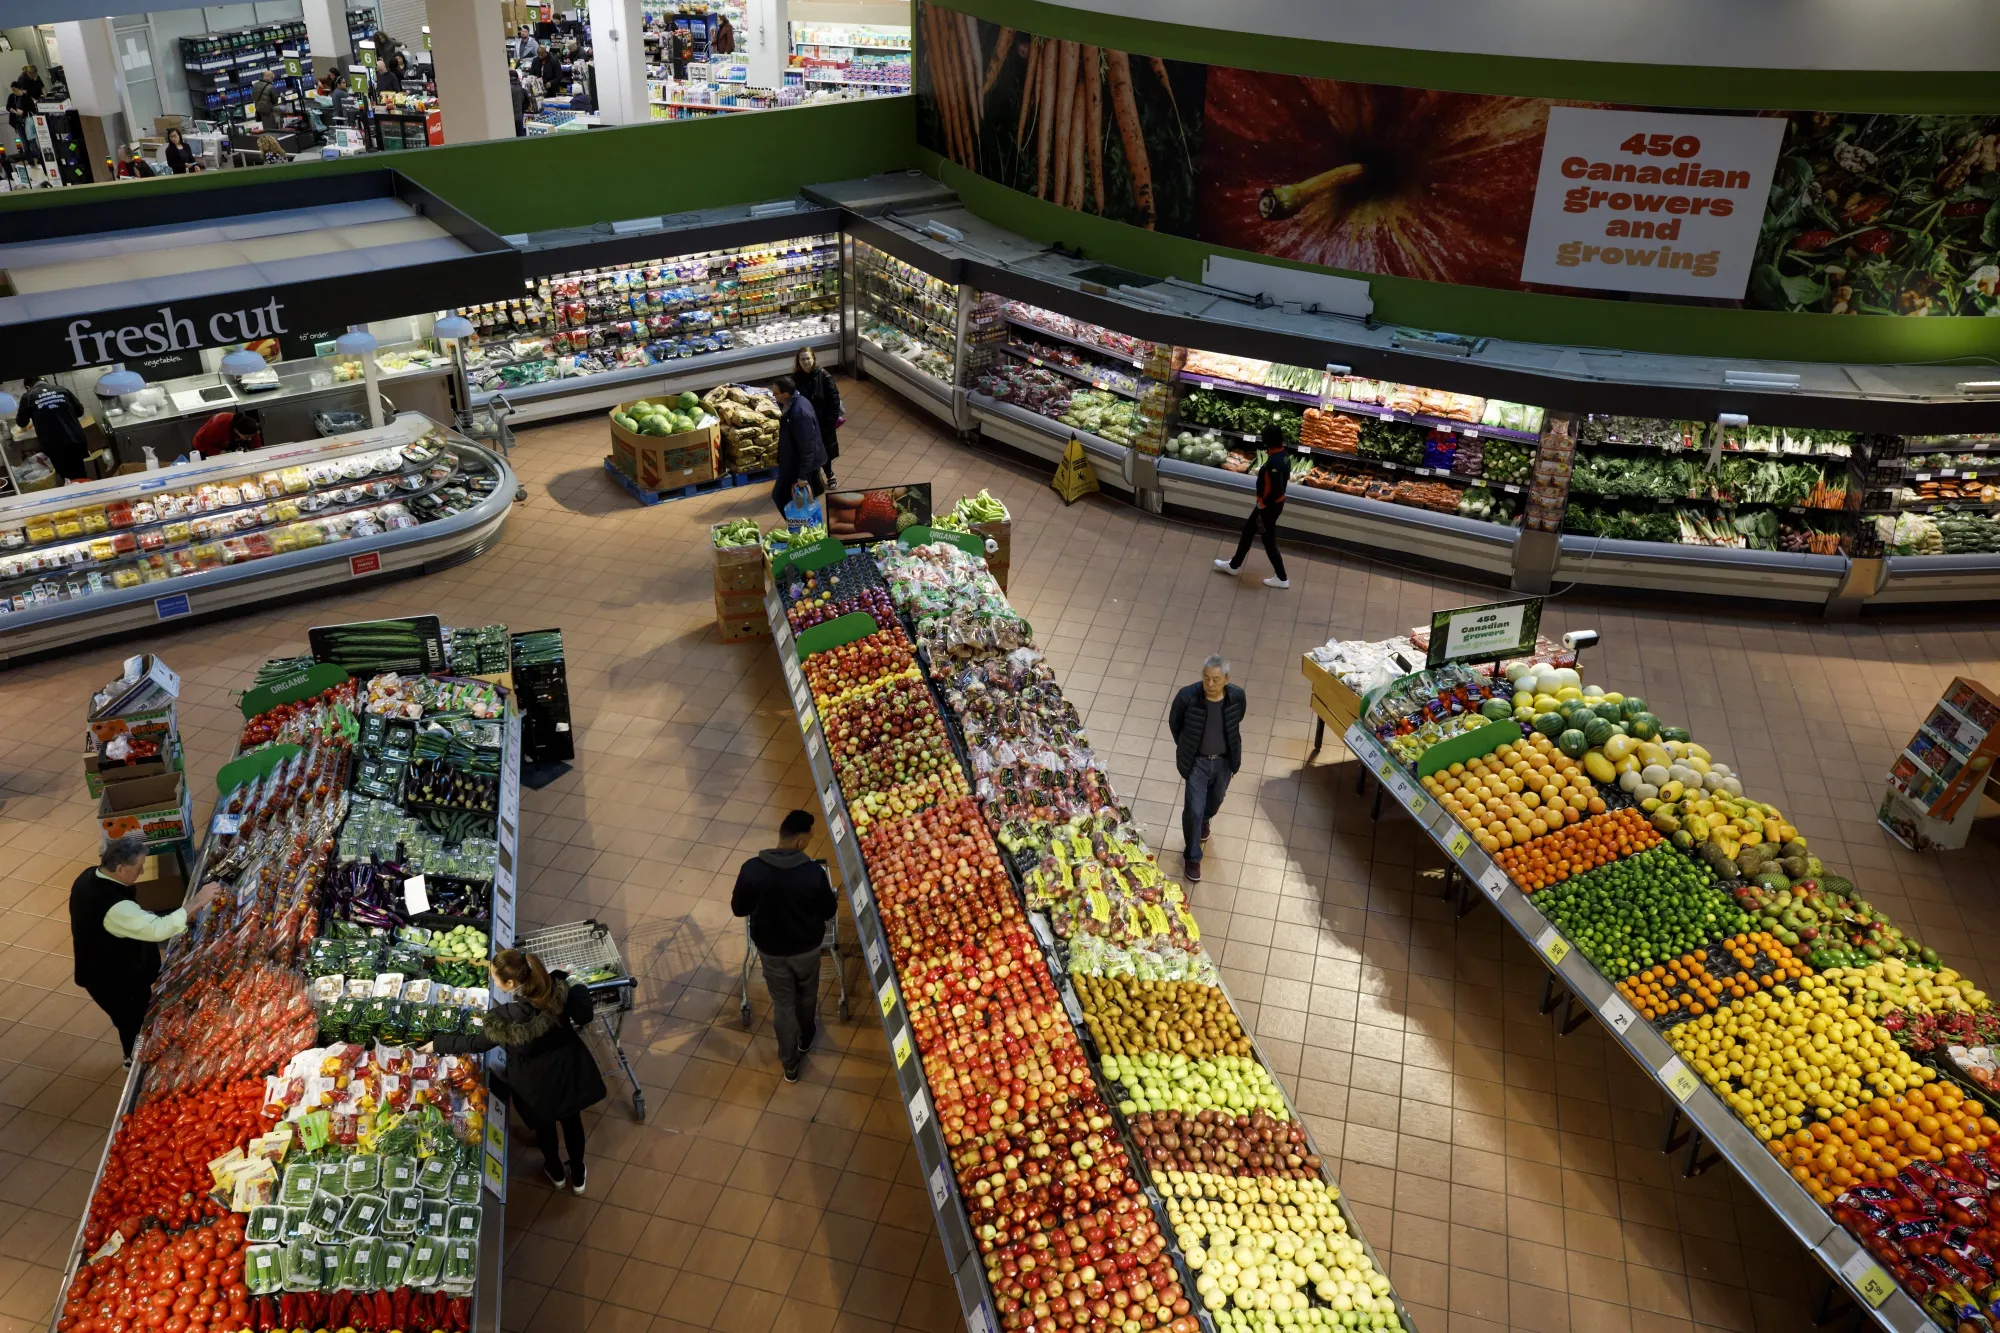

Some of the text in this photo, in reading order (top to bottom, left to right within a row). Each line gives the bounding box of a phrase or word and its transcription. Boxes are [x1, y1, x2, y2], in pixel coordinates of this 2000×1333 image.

[530, 9, 537, 20] 3
[364, 52, 372, 64] 6
[289, 61, 298, 74] 8
[355, 77, 362, 89] 7
[1619, 133, 1701, 159] 450
[1560, 156, 1751, 190] Canadian
[1562, 186, 1735, 217] growers
[1605, 218, 1682, 241] and
[1555, 240, 1721, 278] growing
[65, 295, 288, 368] fresh cut
[299, 333, 310, 342] to
[144, 354, 183, 369] vegetables.
[928, 530, 960, 543] ORGANIC
[788, 543, 822, 561] ORGANIC
[1476, 614, 1497, 624] 450
[1461, 621, 1510, 634] Canadian
[1451, 635, 1515, 651] and growing
[1463, 628, 1505, 643] growers
[270, 674, 310, 694] ORGANIC
